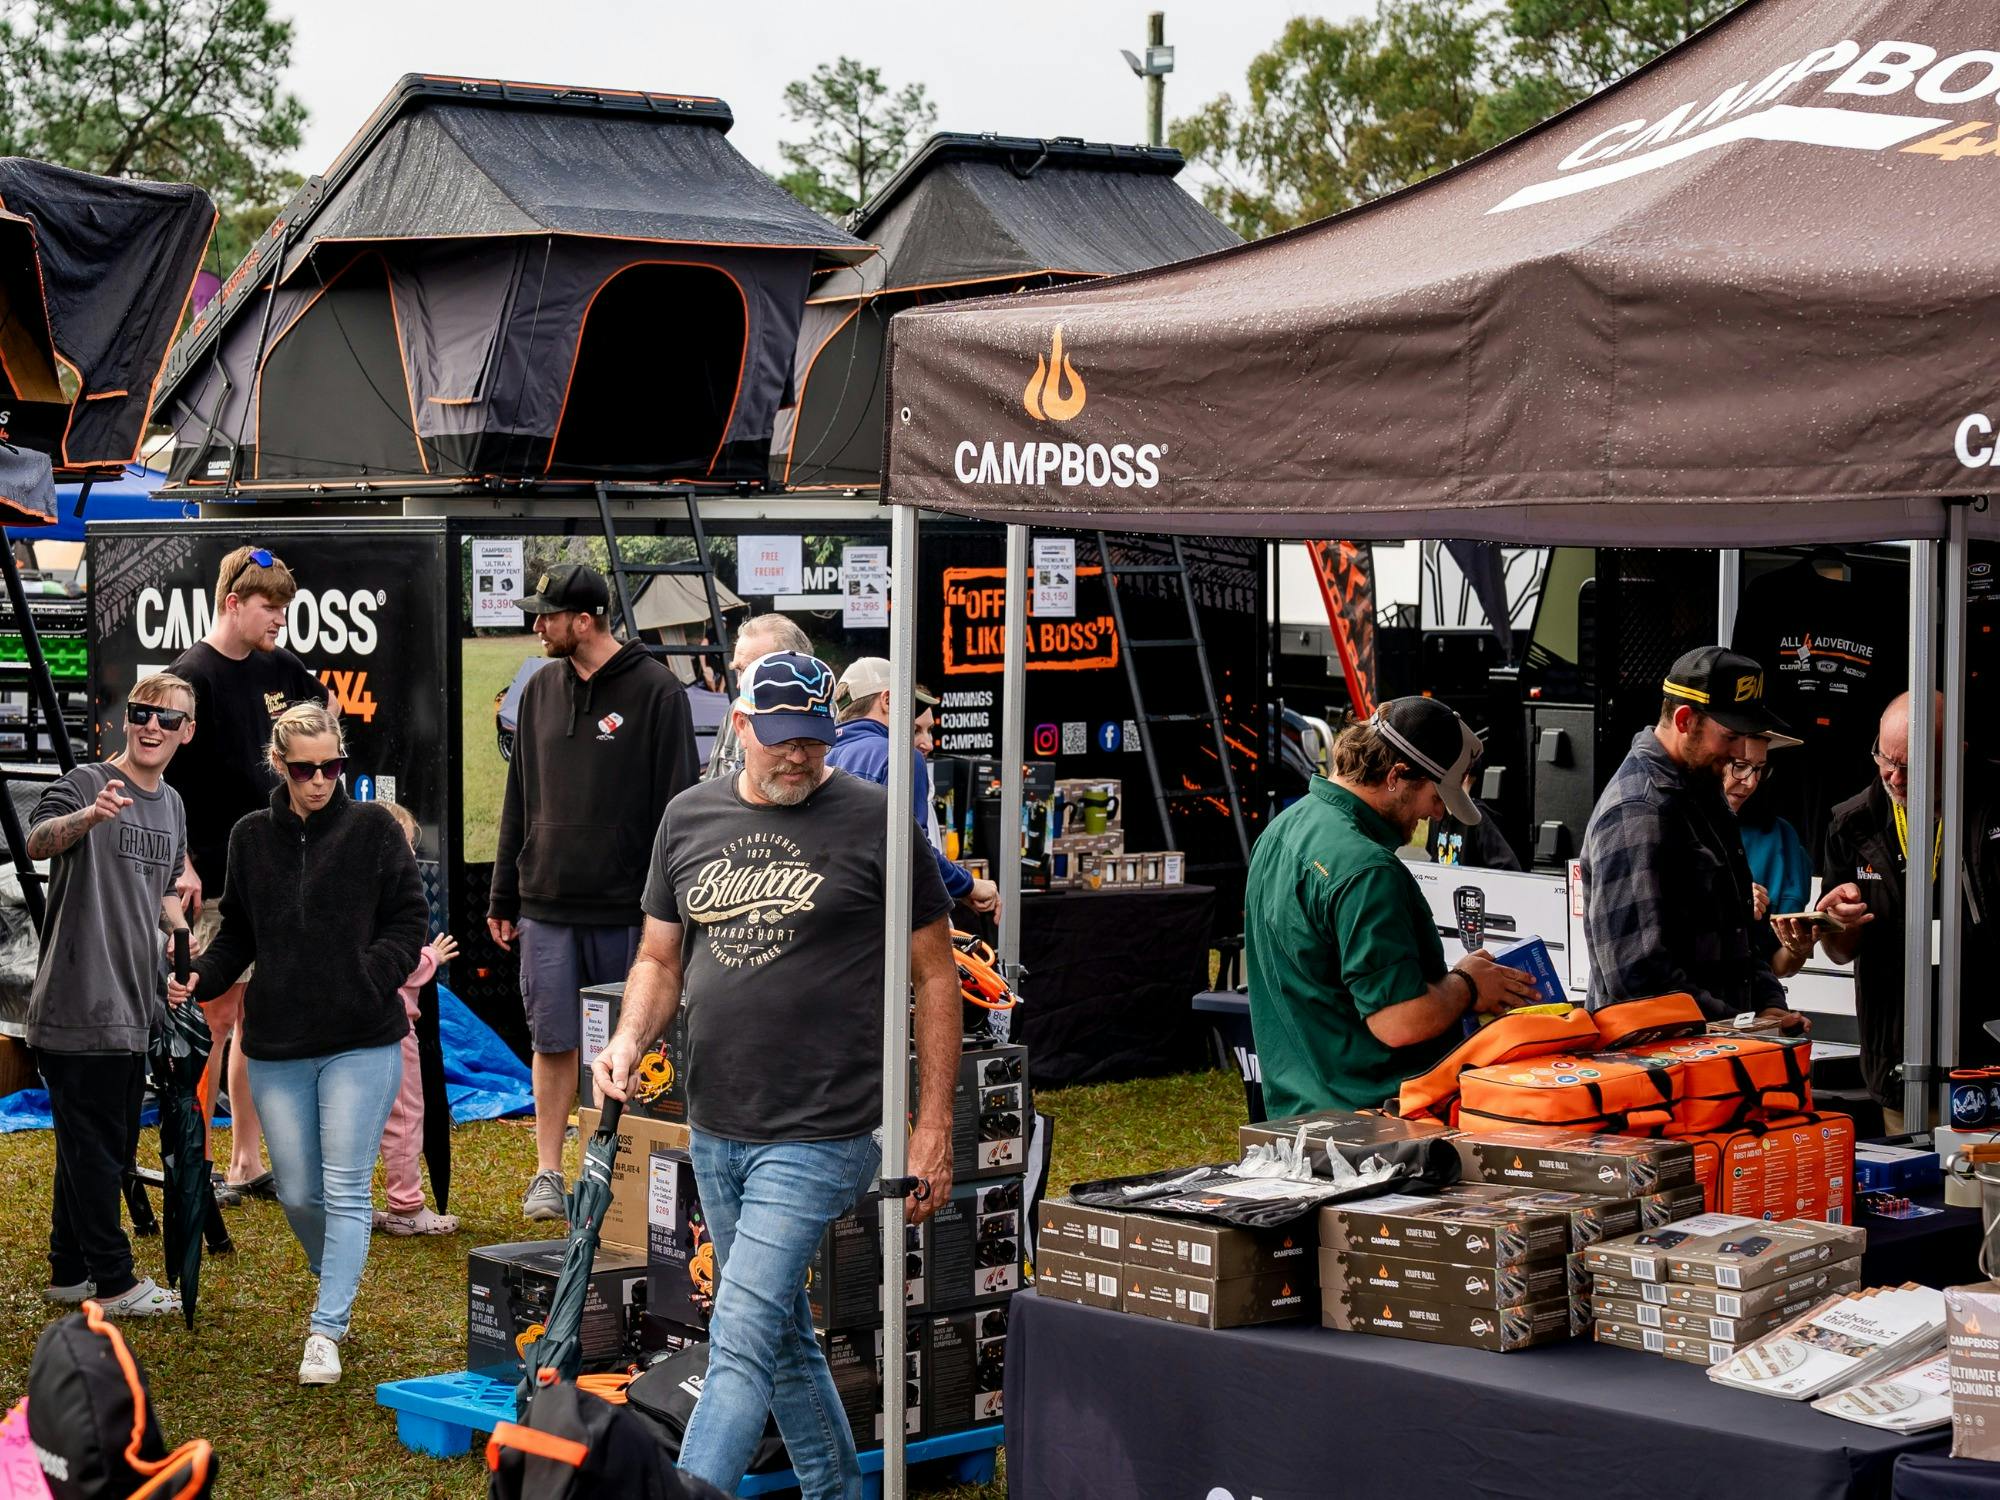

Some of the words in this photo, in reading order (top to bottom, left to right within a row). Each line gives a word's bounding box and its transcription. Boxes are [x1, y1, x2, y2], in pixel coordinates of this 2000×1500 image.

[1557, 39, 2000, 171] CAMPBO
[1899, 120, 2000, 162] 4
[1954, 412, 2000, 469] C
[760, 551, 779, 562] FREE
[754, 566, 785, 577] FREIGHT
[1040, 591, 1069, 602] $3,150
[850, 601, 880, 612] $2,995
[1780, 637, 1802, 647] ALL
[941, 691, 993, 708] AWNINGS
[941, 712, 989, 729] COOKING
[941, 733, 993, 750] CAMPING
[119, 826, 171, 861] GHANDA
[721, 832, 801, 857] ESTABLISHED
[746, 848, 772, 859] 1973
[686, 858, 825, 914] Billabong
[708, 926, 795, 942] BOARDSHORT
[710, 940, 744, 969] SEVENTY
[750, 944, 782, 967] THREE
[1733, 1150, 1747, 1160] FIRST
[1747, 1150, 1755, 1158] AID
[1539, 1160, 1555, 1169] KNIFE
[1555, 1161, 1569, 1170] ROLL
[1504, 1168, 1534, 1178] CAMPBOSS
[1405, 1227, 1422, 1237] KNIFE
[1423, 1229, 1437, 1239] ROLL
[1371, 1236, 1400, 1248] CAMPBOSS
[651, 1242, 662, 1255] TYRE
[663, 1245, 686, 1260] DEFLATOR
[1273, 1247, 1304, 1259] CAMPBOSS
[1405, 1269, 1421, 1279] KNIFE
[1422, 1271, 1436, 1281] ROLL
[1369, 1277, 1399, 1288] CAMPBOSS
[471, 1299, 486, 1313] BOSS
[487, 1302, 495, 1315] AIR
[1271, 1296, 1302, 1307] CAMPBOSS
[1409, 1309, 1426, 1319] KNIFE
[1426, 1312, 1440, 1322] ROLL
[1823, 1314, 1850, 1330] that
[1373, 1318, 1403, 1329] CAMPBOSS
[471, 1322, 507, 1341] COMPRESSOR
[933, 1338, 962, 1349] COMPRESSOR
[1950, 1336, 1999, 1350] CAMPBOSS
[831, 1355, 861, 1367] COMPRESSOR
[1951, 1366, 1996, 1383] ULTIMATE
[1951, 1382, 1994, 1398] COOKING
